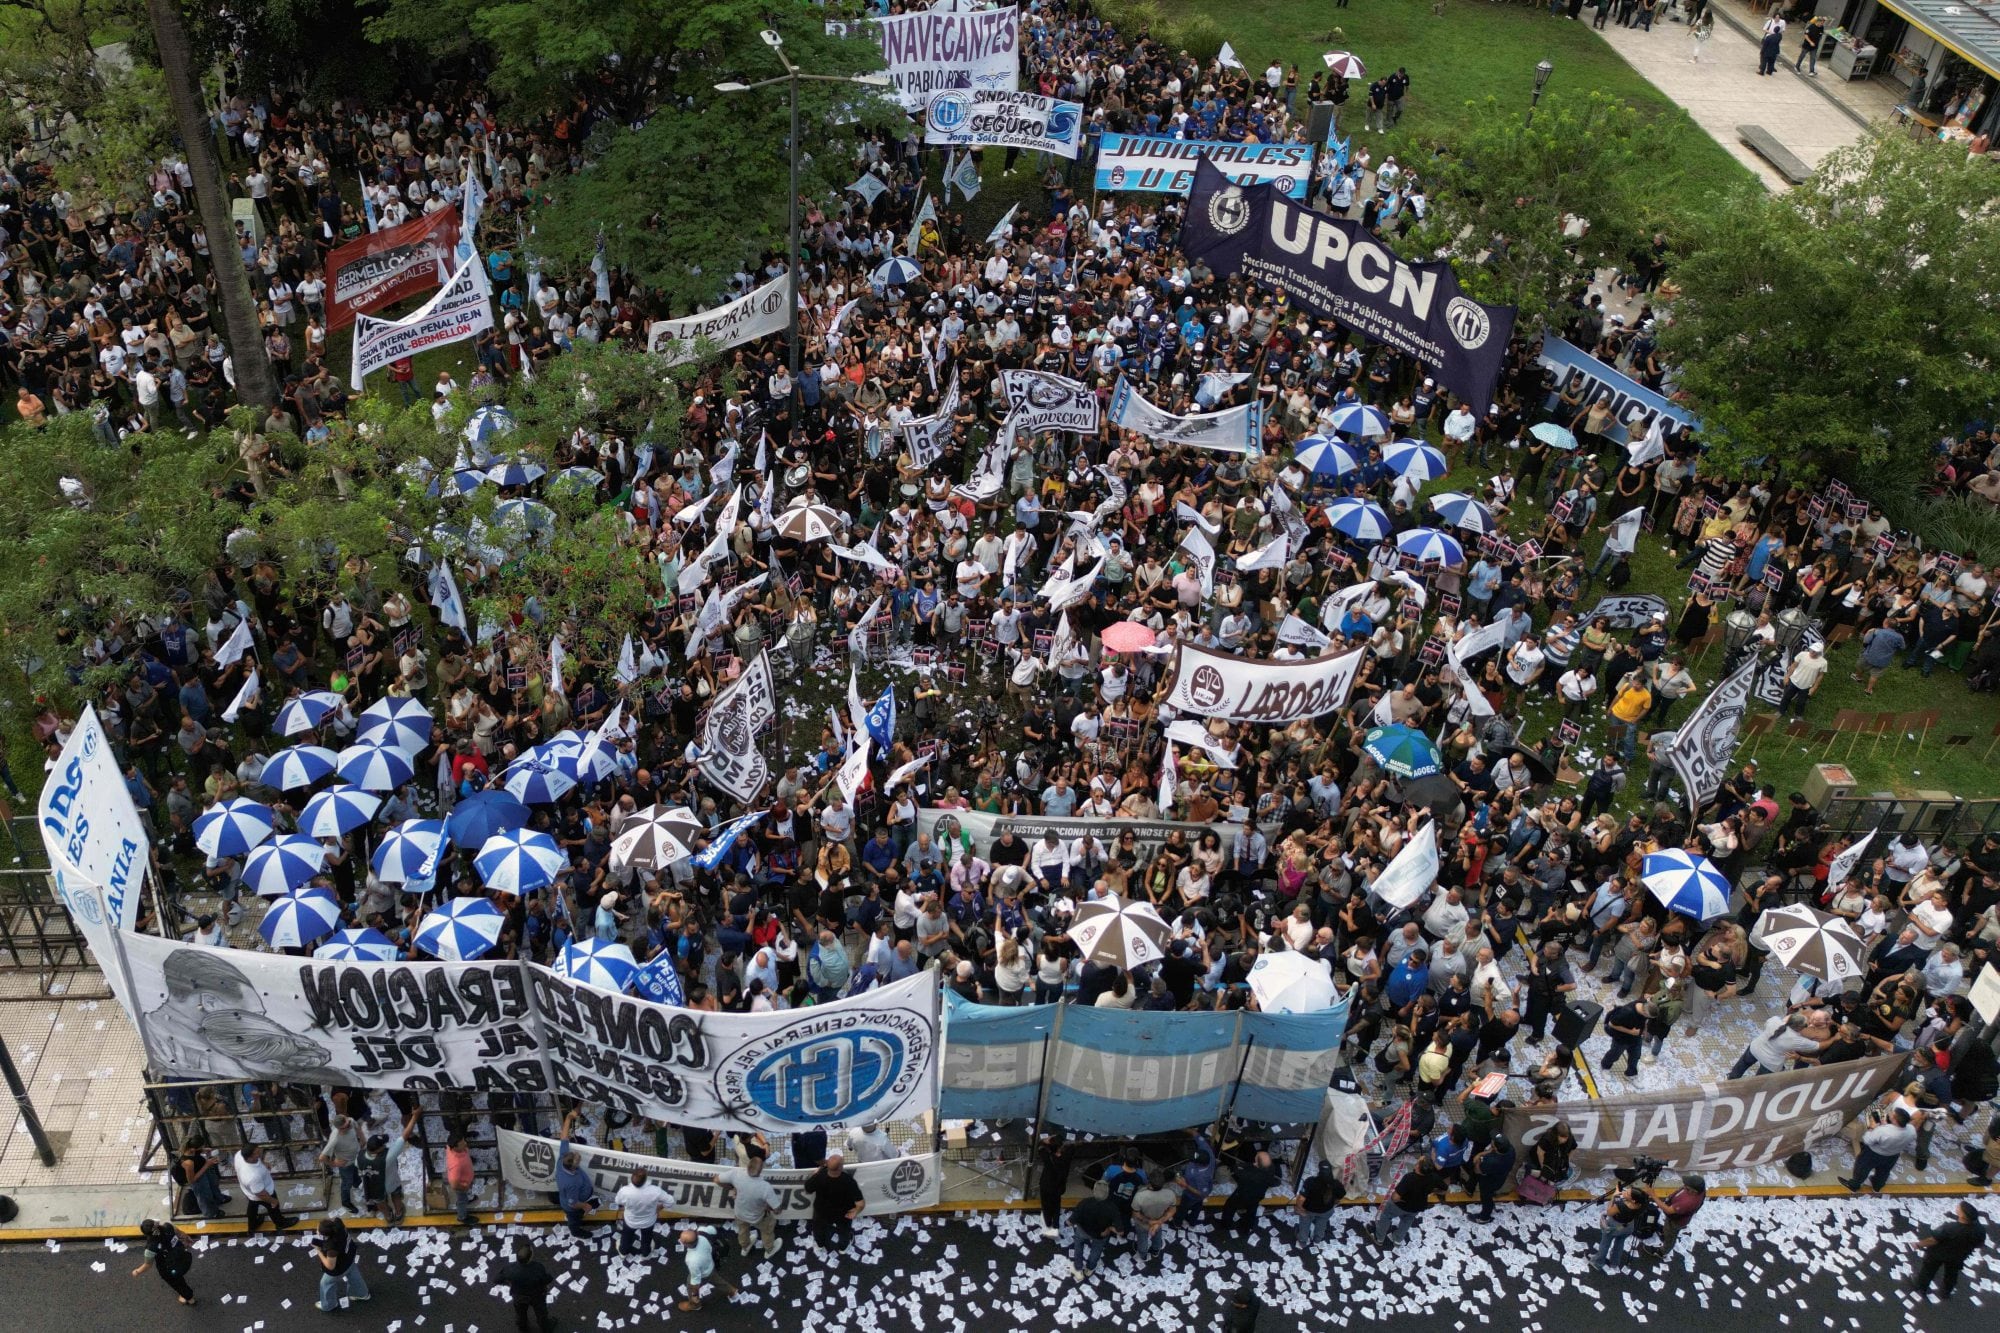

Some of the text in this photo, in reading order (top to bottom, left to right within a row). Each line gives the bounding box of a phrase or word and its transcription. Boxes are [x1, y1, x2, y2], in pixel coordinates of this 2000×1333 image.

[881, 9, 1017, 64] NAVEGANTES
[973, 89, 1047, 111] SINDICATO
[997, 104, 1021, 117] DEL
[970, 116, 1044, 136] SEGURO
[947, 131, 974, 144] Jorge
[1001, 134, 1056, 150] Conducción
[1105, 137, 1307, 167] JUDICIALES
[1270, 201, 1438, 321] UPCN
[1242, 252, 1286, 275] Seccional
[1287, 267, 1350, 309] Trabajador@s
[1351, 302, 1393, 328] Públicos
[1395, 321, 1447, 358] Nacionales
[379, 328, 419, 350] INTERNA
[420, 318, 454, 334] PENAL
[455, 308, 482, 325] UEJN
[1264, 272, 1308, 300] Gobierno
[1308, 292, 1321, 307] de
[1321, 297, 1332, 312] la
[1333, 305, 1367, 330] Ciudad
[1367, 323, 1381, 336] de
[1382, 329, 1416, 354] Buenos
[1416, 349, 1443, 369] Aires
[1365, 743, 1388, 765] AGOEC
[1413, 764, 1437, 778] AGOEC
[1152, 829, 1164, 837] SE
